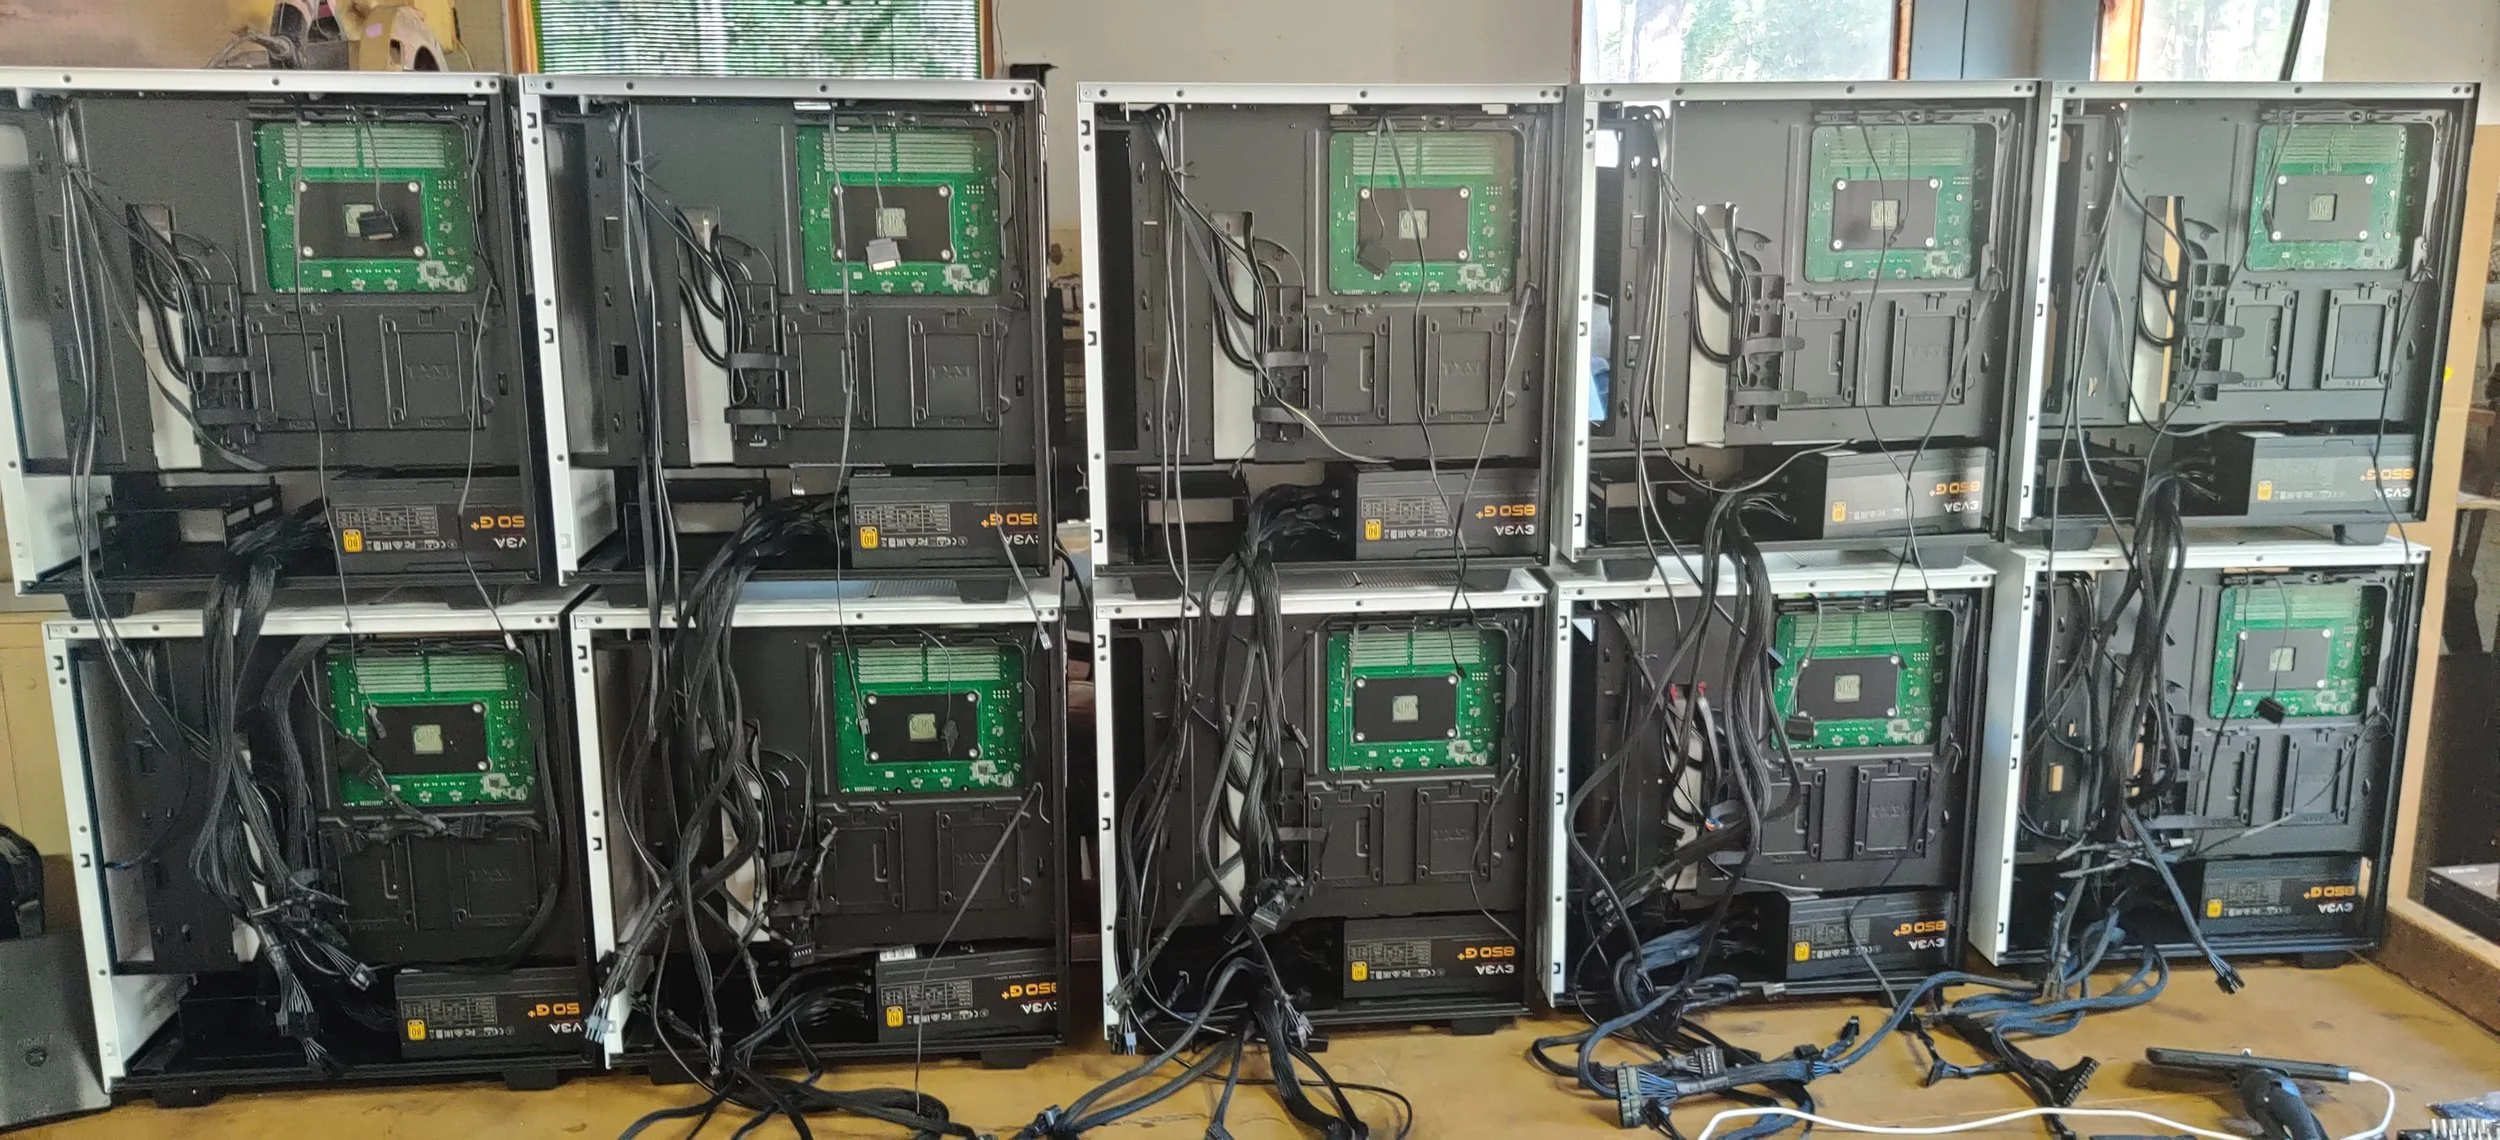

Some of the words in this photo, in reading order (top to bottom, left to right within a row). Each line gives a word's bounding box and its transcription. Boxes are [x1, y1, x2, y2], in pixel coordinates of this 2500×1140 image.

[2381, 468, 2416, 480] 850
[1949, 481, 1981, 494] 850
[1500, 505, 1537, 517] 850
[1943, 502, 1981, 514] EVGA
[1492, 524, 1537, 536] EVGA
[2317, 902, 2354, 914] EVGA
[1914, 920, 1948, 933] 850
[1908, 938, 1947, 950] EVGA
[1480, 946, 1516, 958] 850
[1475, 964, 1516, 976] EVGA
